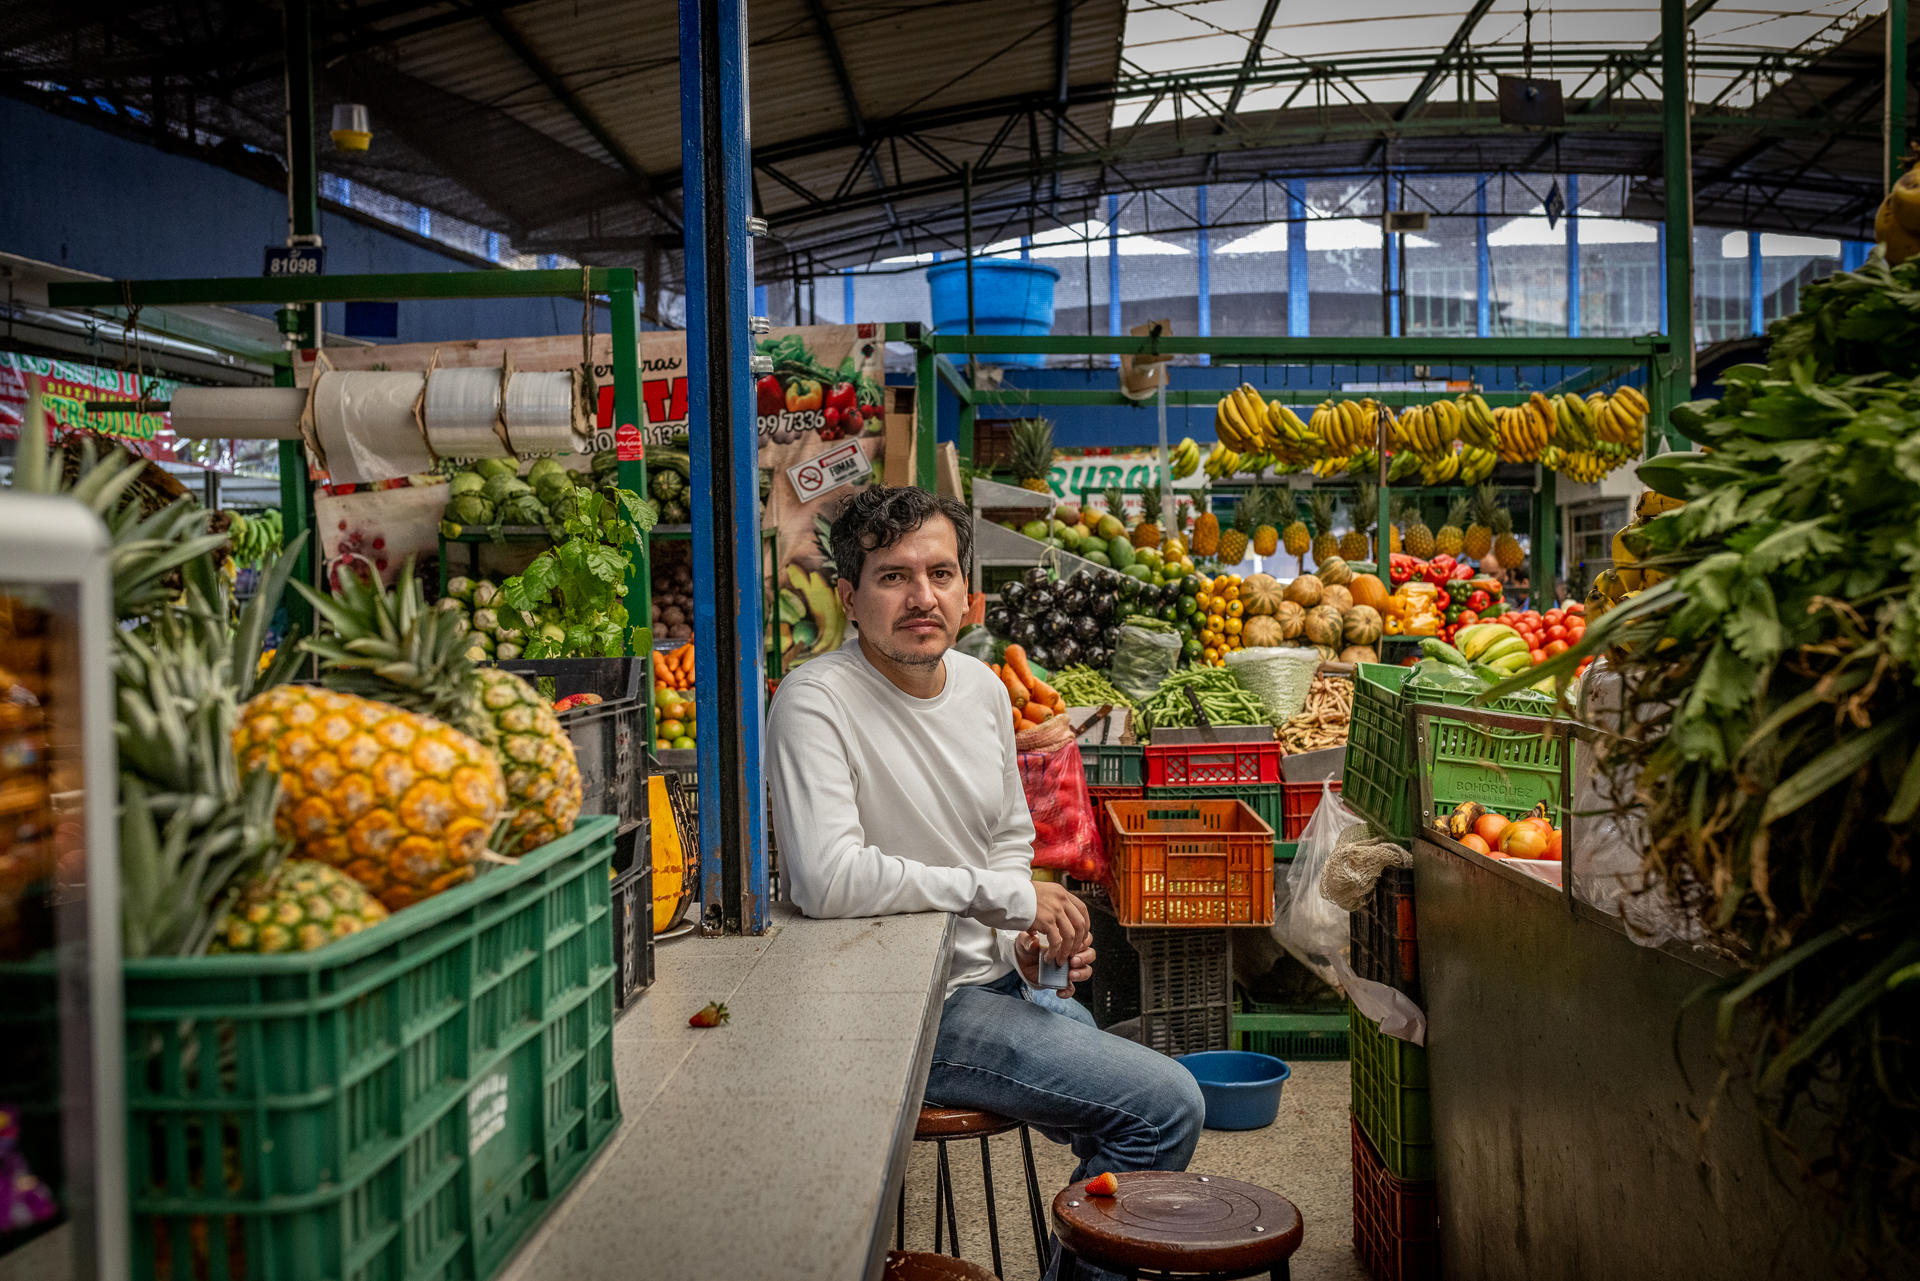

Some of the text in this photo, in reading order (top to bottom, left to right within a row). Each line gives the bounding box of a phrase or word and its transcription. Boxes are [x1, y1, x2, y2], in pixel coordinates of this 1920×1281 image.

[271, 258, 317, 273] 81098
[783, 410, 825, 433] 7336
[829, 458, 858, 478] FUMAR
